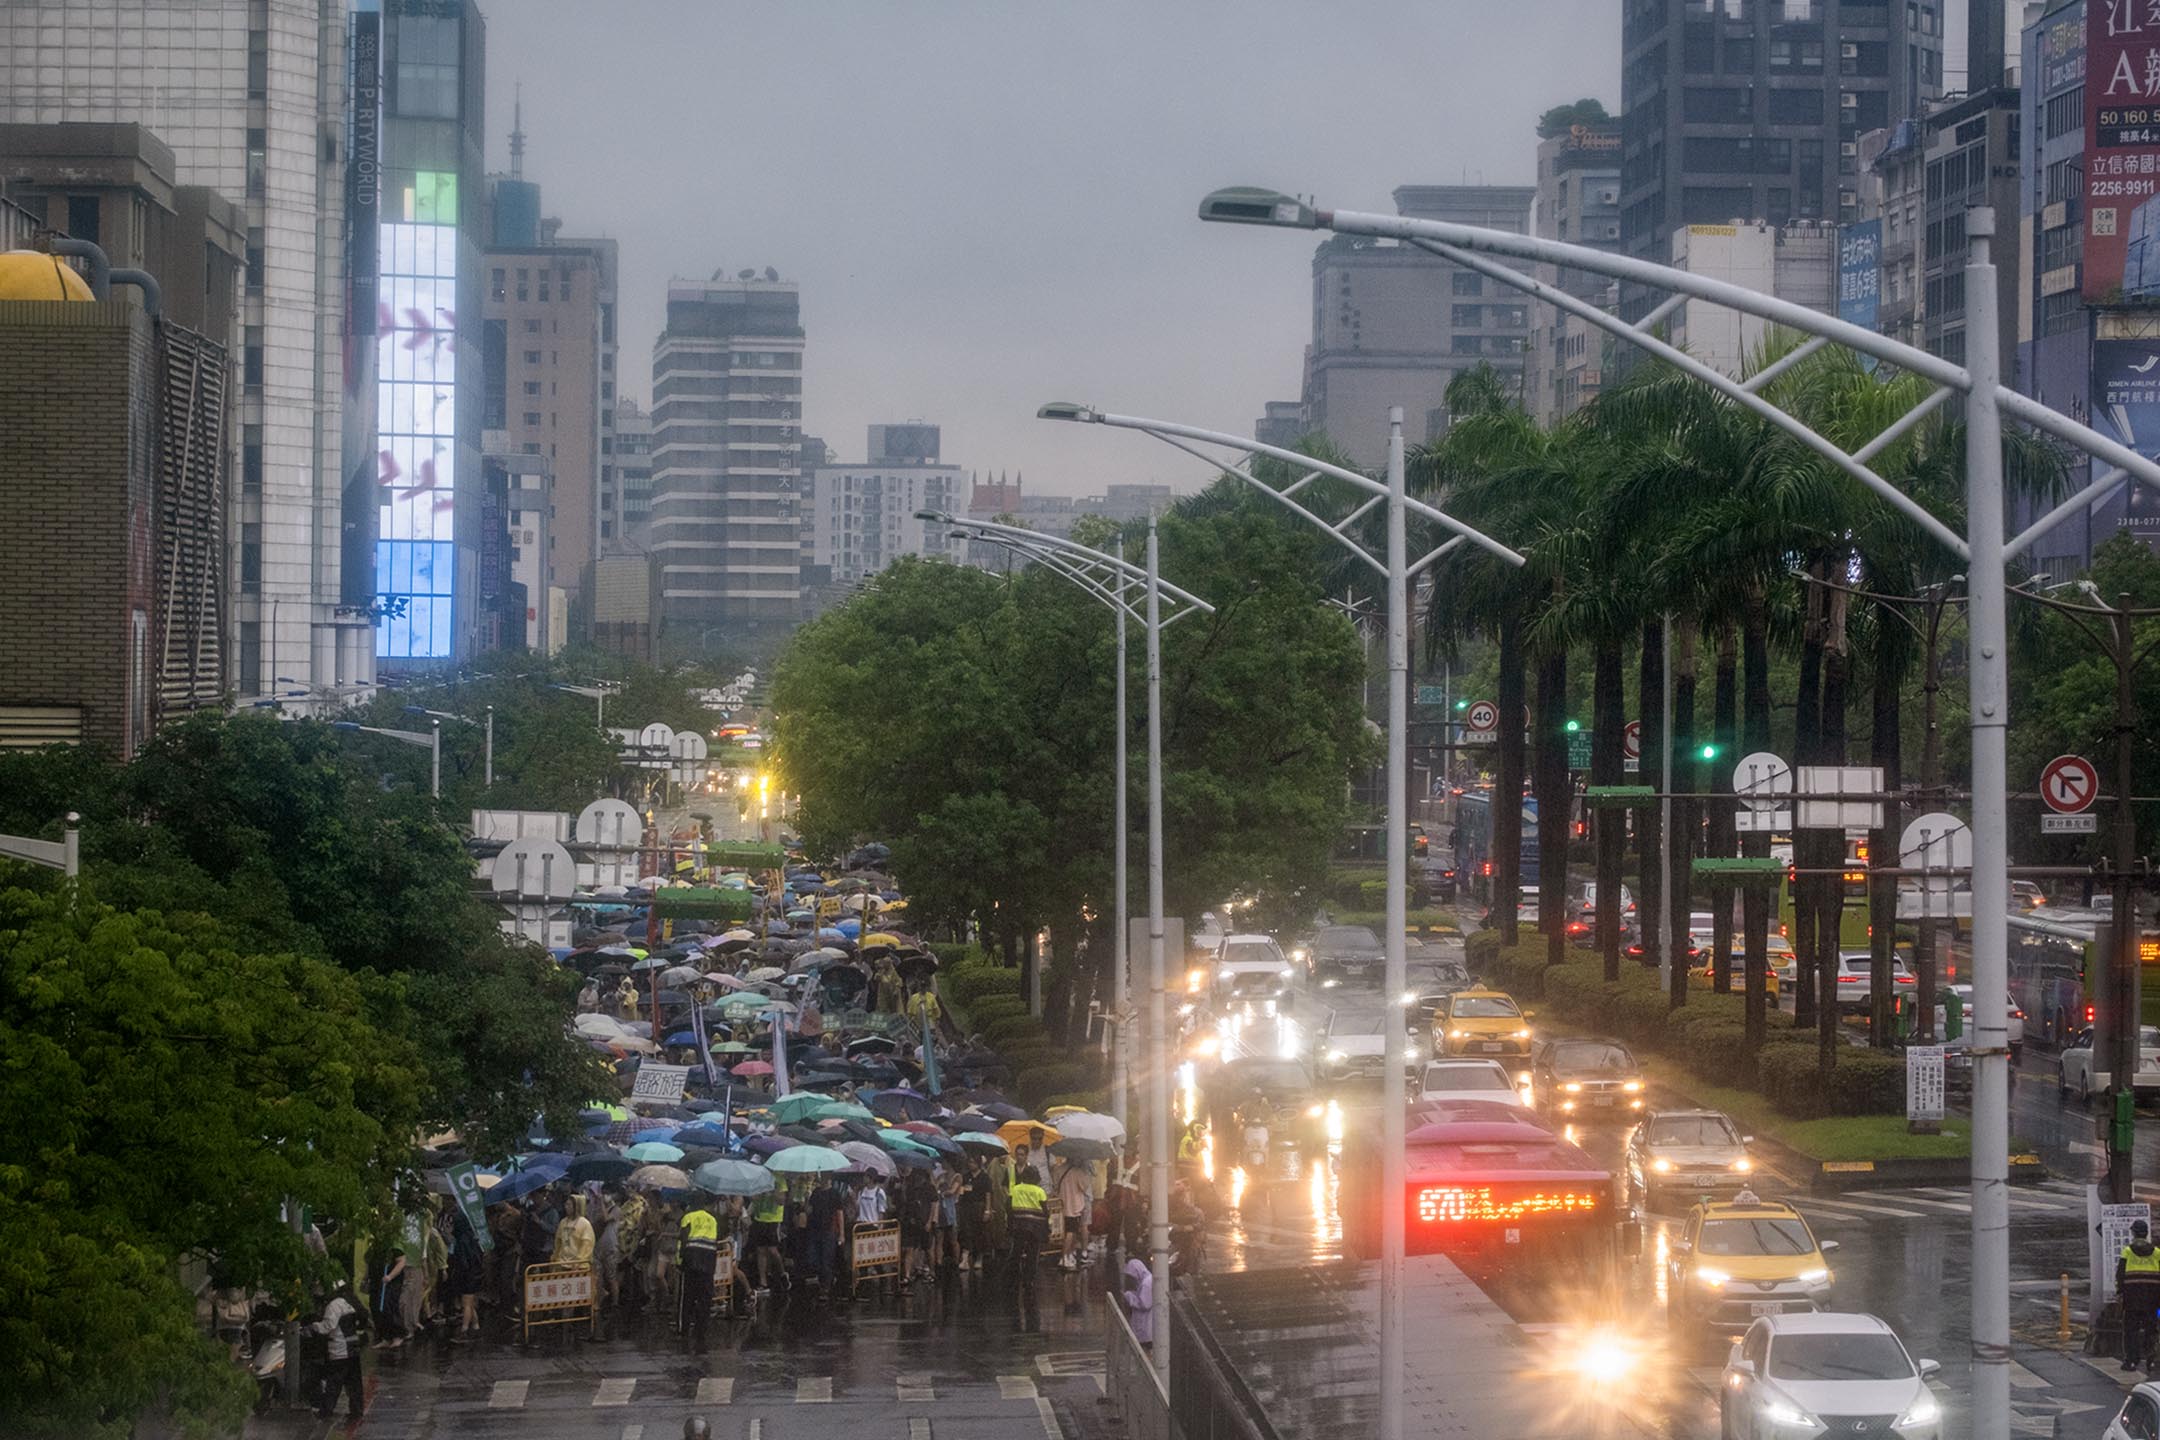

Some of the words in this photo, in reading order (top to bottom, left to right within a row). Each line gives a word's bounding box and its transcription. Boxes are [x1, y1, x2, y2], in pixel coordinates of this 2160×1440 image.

[2123, 110, 2148, 124] 160
[358, 88, 375, 206] PRTYWORLD
[2091, 180, 2155, 196] 2256-9911
[1473, 711, 1492, 722] 40
[1419, 1188, 1464, 1221] 670
